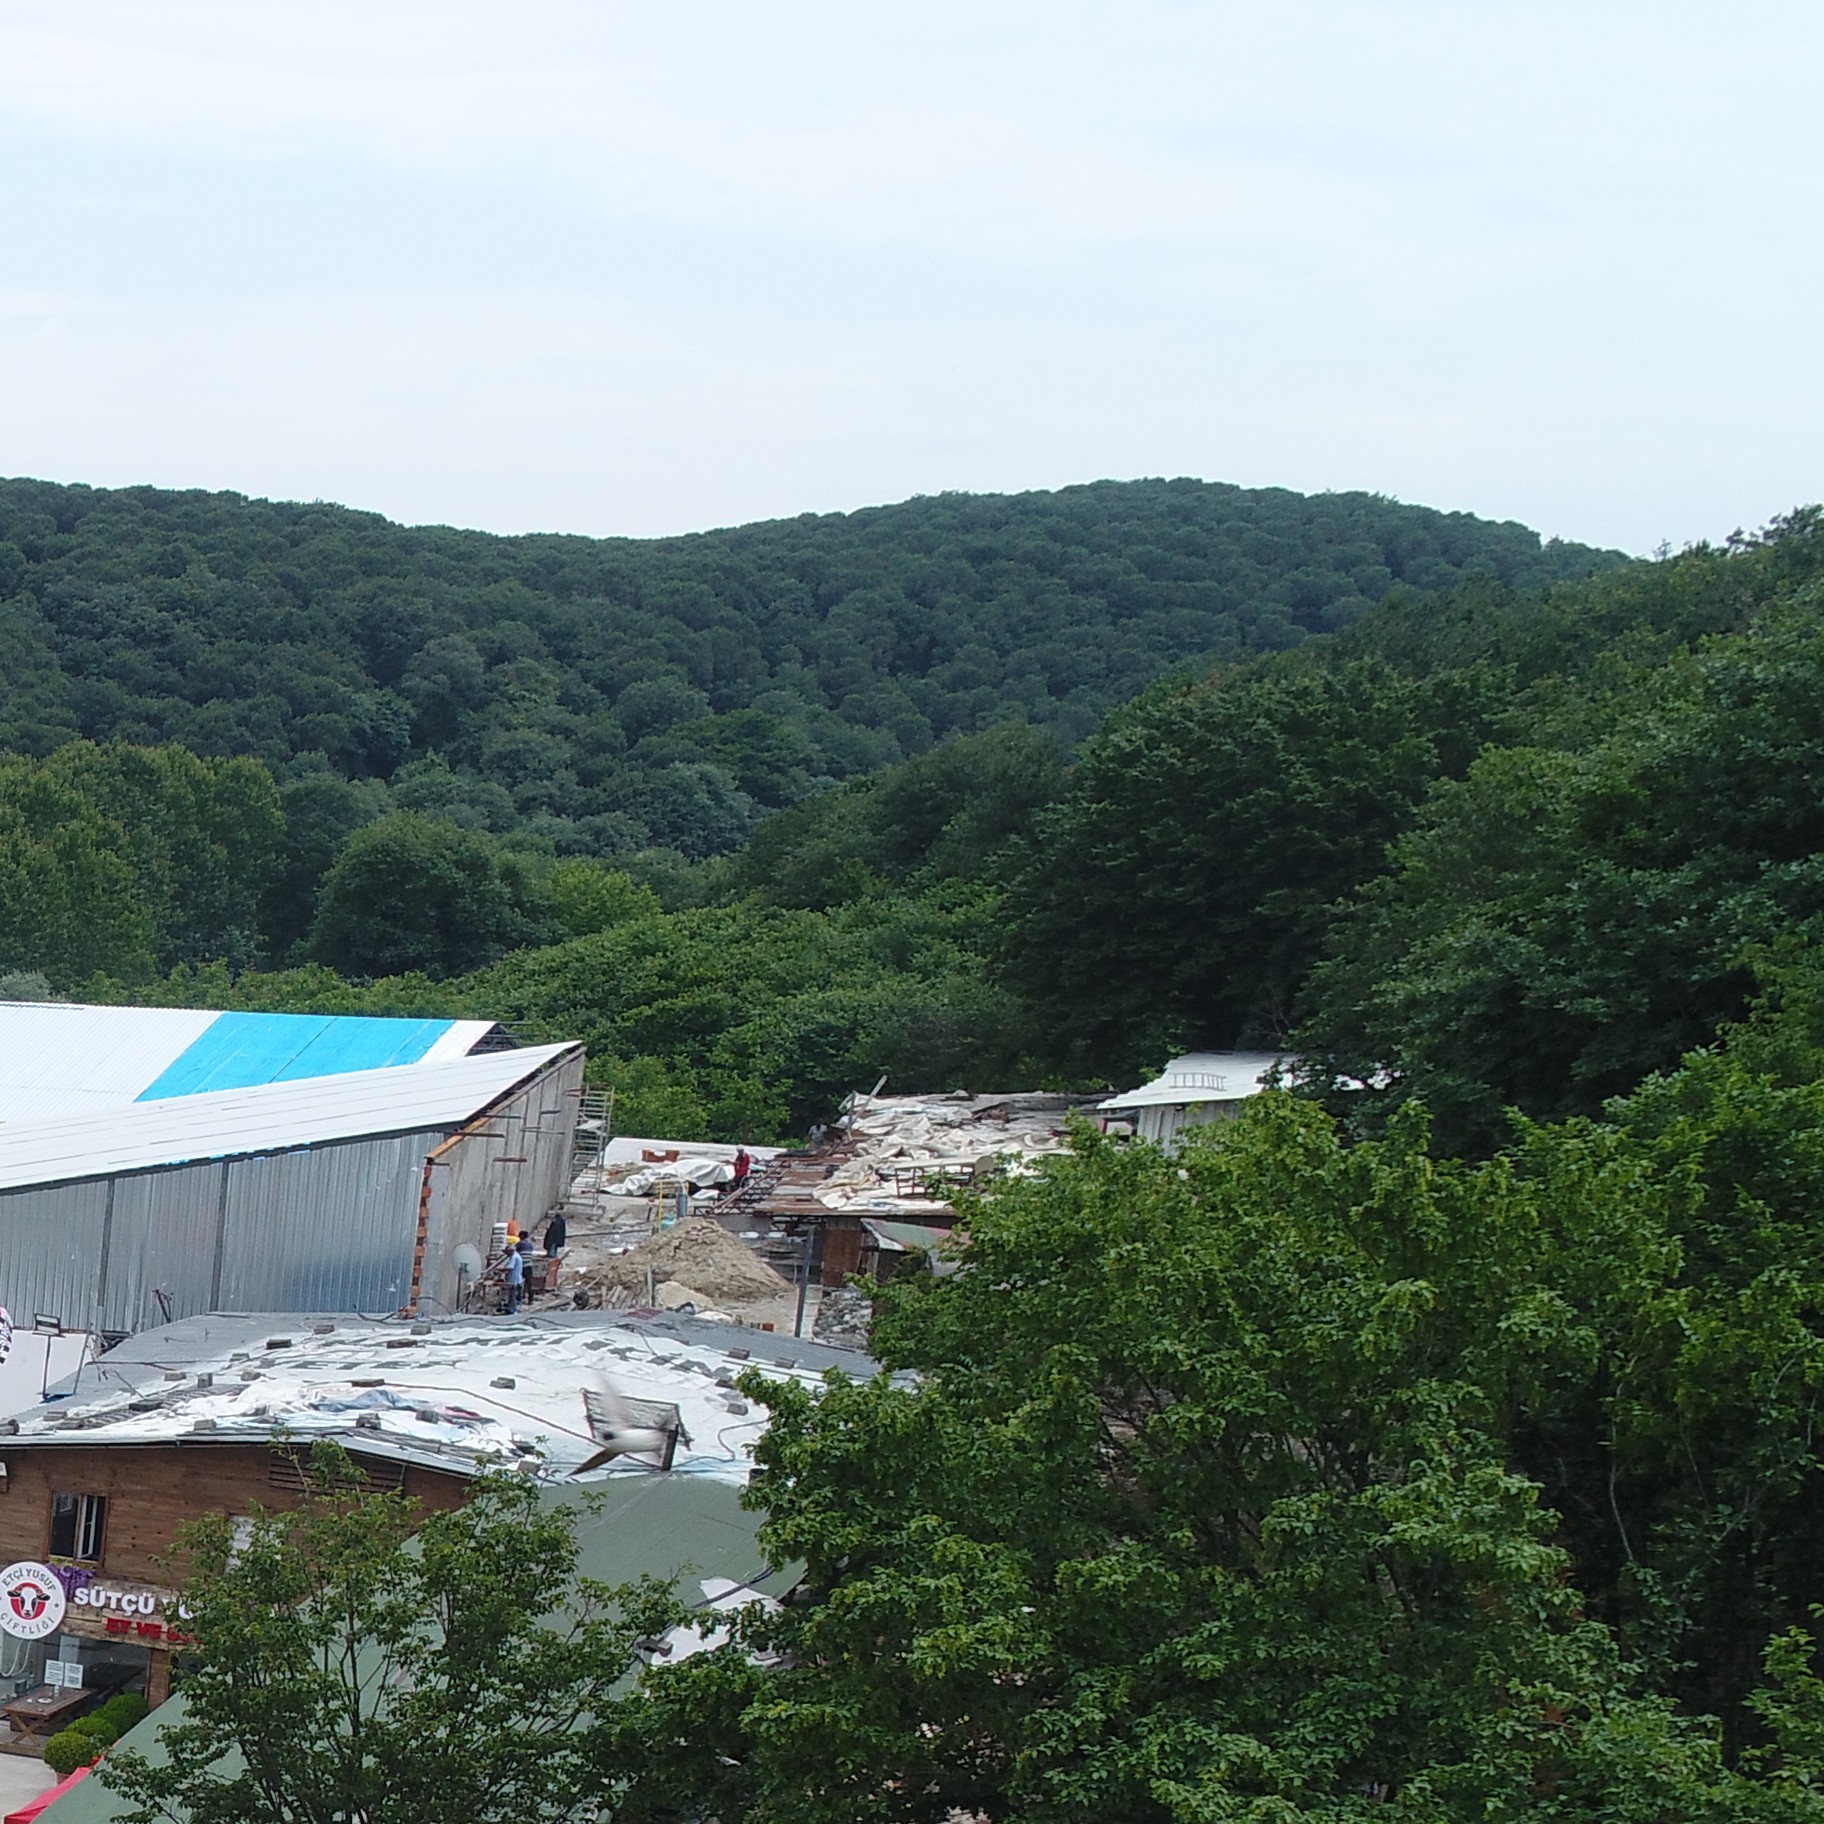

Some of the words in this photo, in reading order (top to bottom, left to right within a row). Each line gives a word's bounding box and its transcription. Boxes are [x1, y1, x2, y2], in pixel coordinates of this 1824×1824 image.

[1, 1567, 24, 1587] ETÇİ
[25, 1568, 57, 1591] YUSUF
[73, 1585, 156, 1617] SÜTÇÜ
[106, 1617, 132, 1635] ET
[135, 1621, 163, 1640] VE
